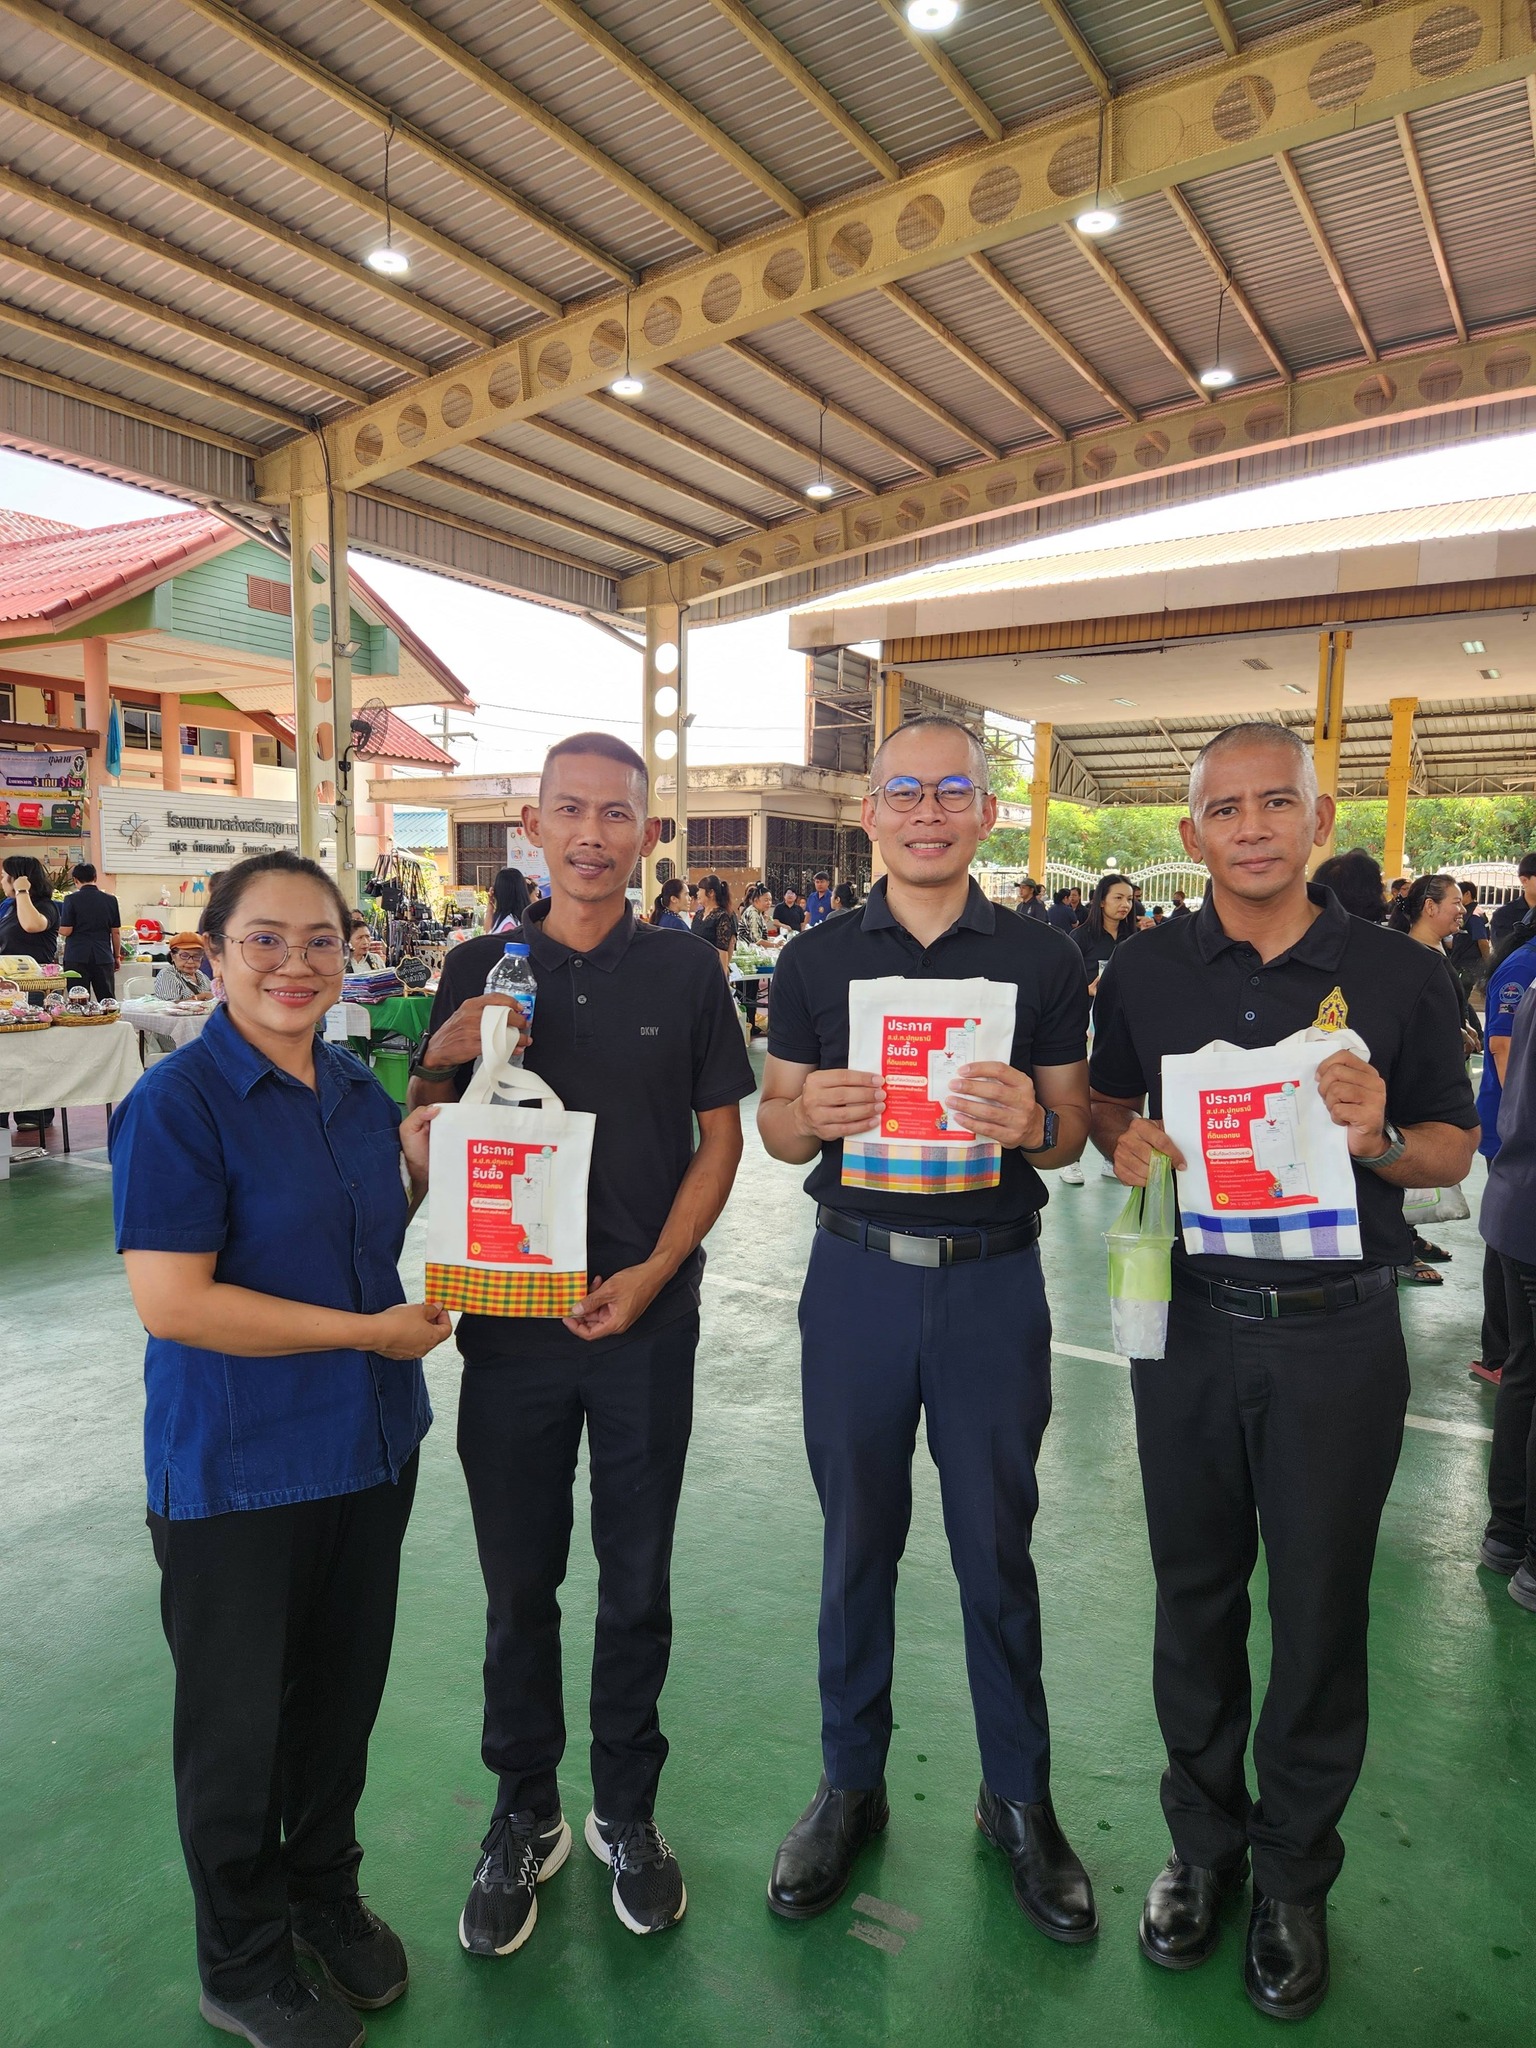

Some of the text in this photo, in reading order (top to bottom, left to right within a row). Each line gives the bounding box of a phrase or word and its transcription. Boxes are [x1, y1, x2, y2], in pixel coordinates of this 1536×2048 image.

[48, 755, 72, 766] ยุงลาย
[33, 776, 40, 787] 3
[41, 773, 57, 788] เก็บ
[59, 776, 65, 788] 3
[67, 774, 83, 788] โรค
[640, 1026, 659, 1036] DKNY
[888, 1019, 932, 1032] ประกาศ
[887, 1042, 919, 1057] รับซื้อ
[1206, 1092, 1252, 1105] ประกาศ
[1207, 1113, 1240, 1130] รับซื้อ
[1207, 1131, 1241, 1140] ที่ดินเอกชน
[472, 1143, 515, 1156] ประกาศ
[472, 1164, 504, 1180] รับซื้อ
